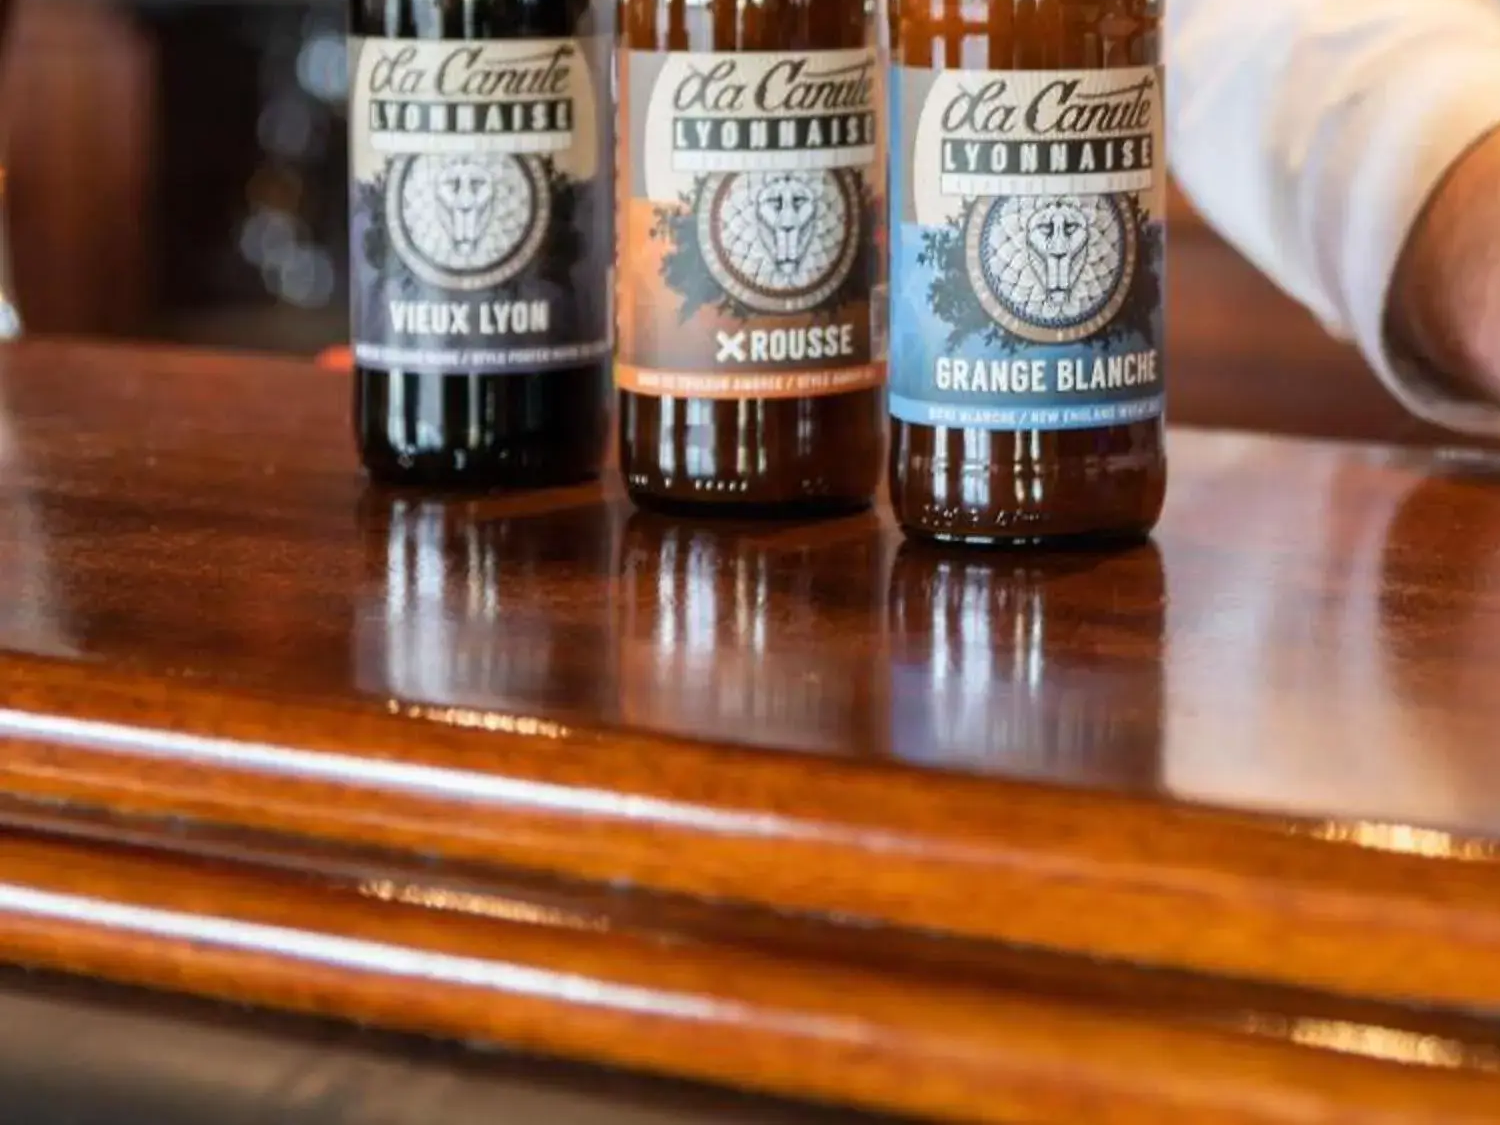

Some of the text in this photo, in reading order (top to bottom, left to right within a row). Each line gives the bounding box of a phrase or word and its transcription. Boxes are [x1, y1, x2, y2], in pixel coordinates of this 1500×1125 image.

[369, 43, 574, 96] La Canute
[673, 59, 744, 112] La
[372, 102, 568, 131] LYONNAISE
[941, 75, 1154, 135] La Canute
[943, 138, 1151, 173] LYONNAISE
[390, 299, 550, 335] VIEUX LYON
[936, 350, 1158, 393] GRANGE BLANCHE
